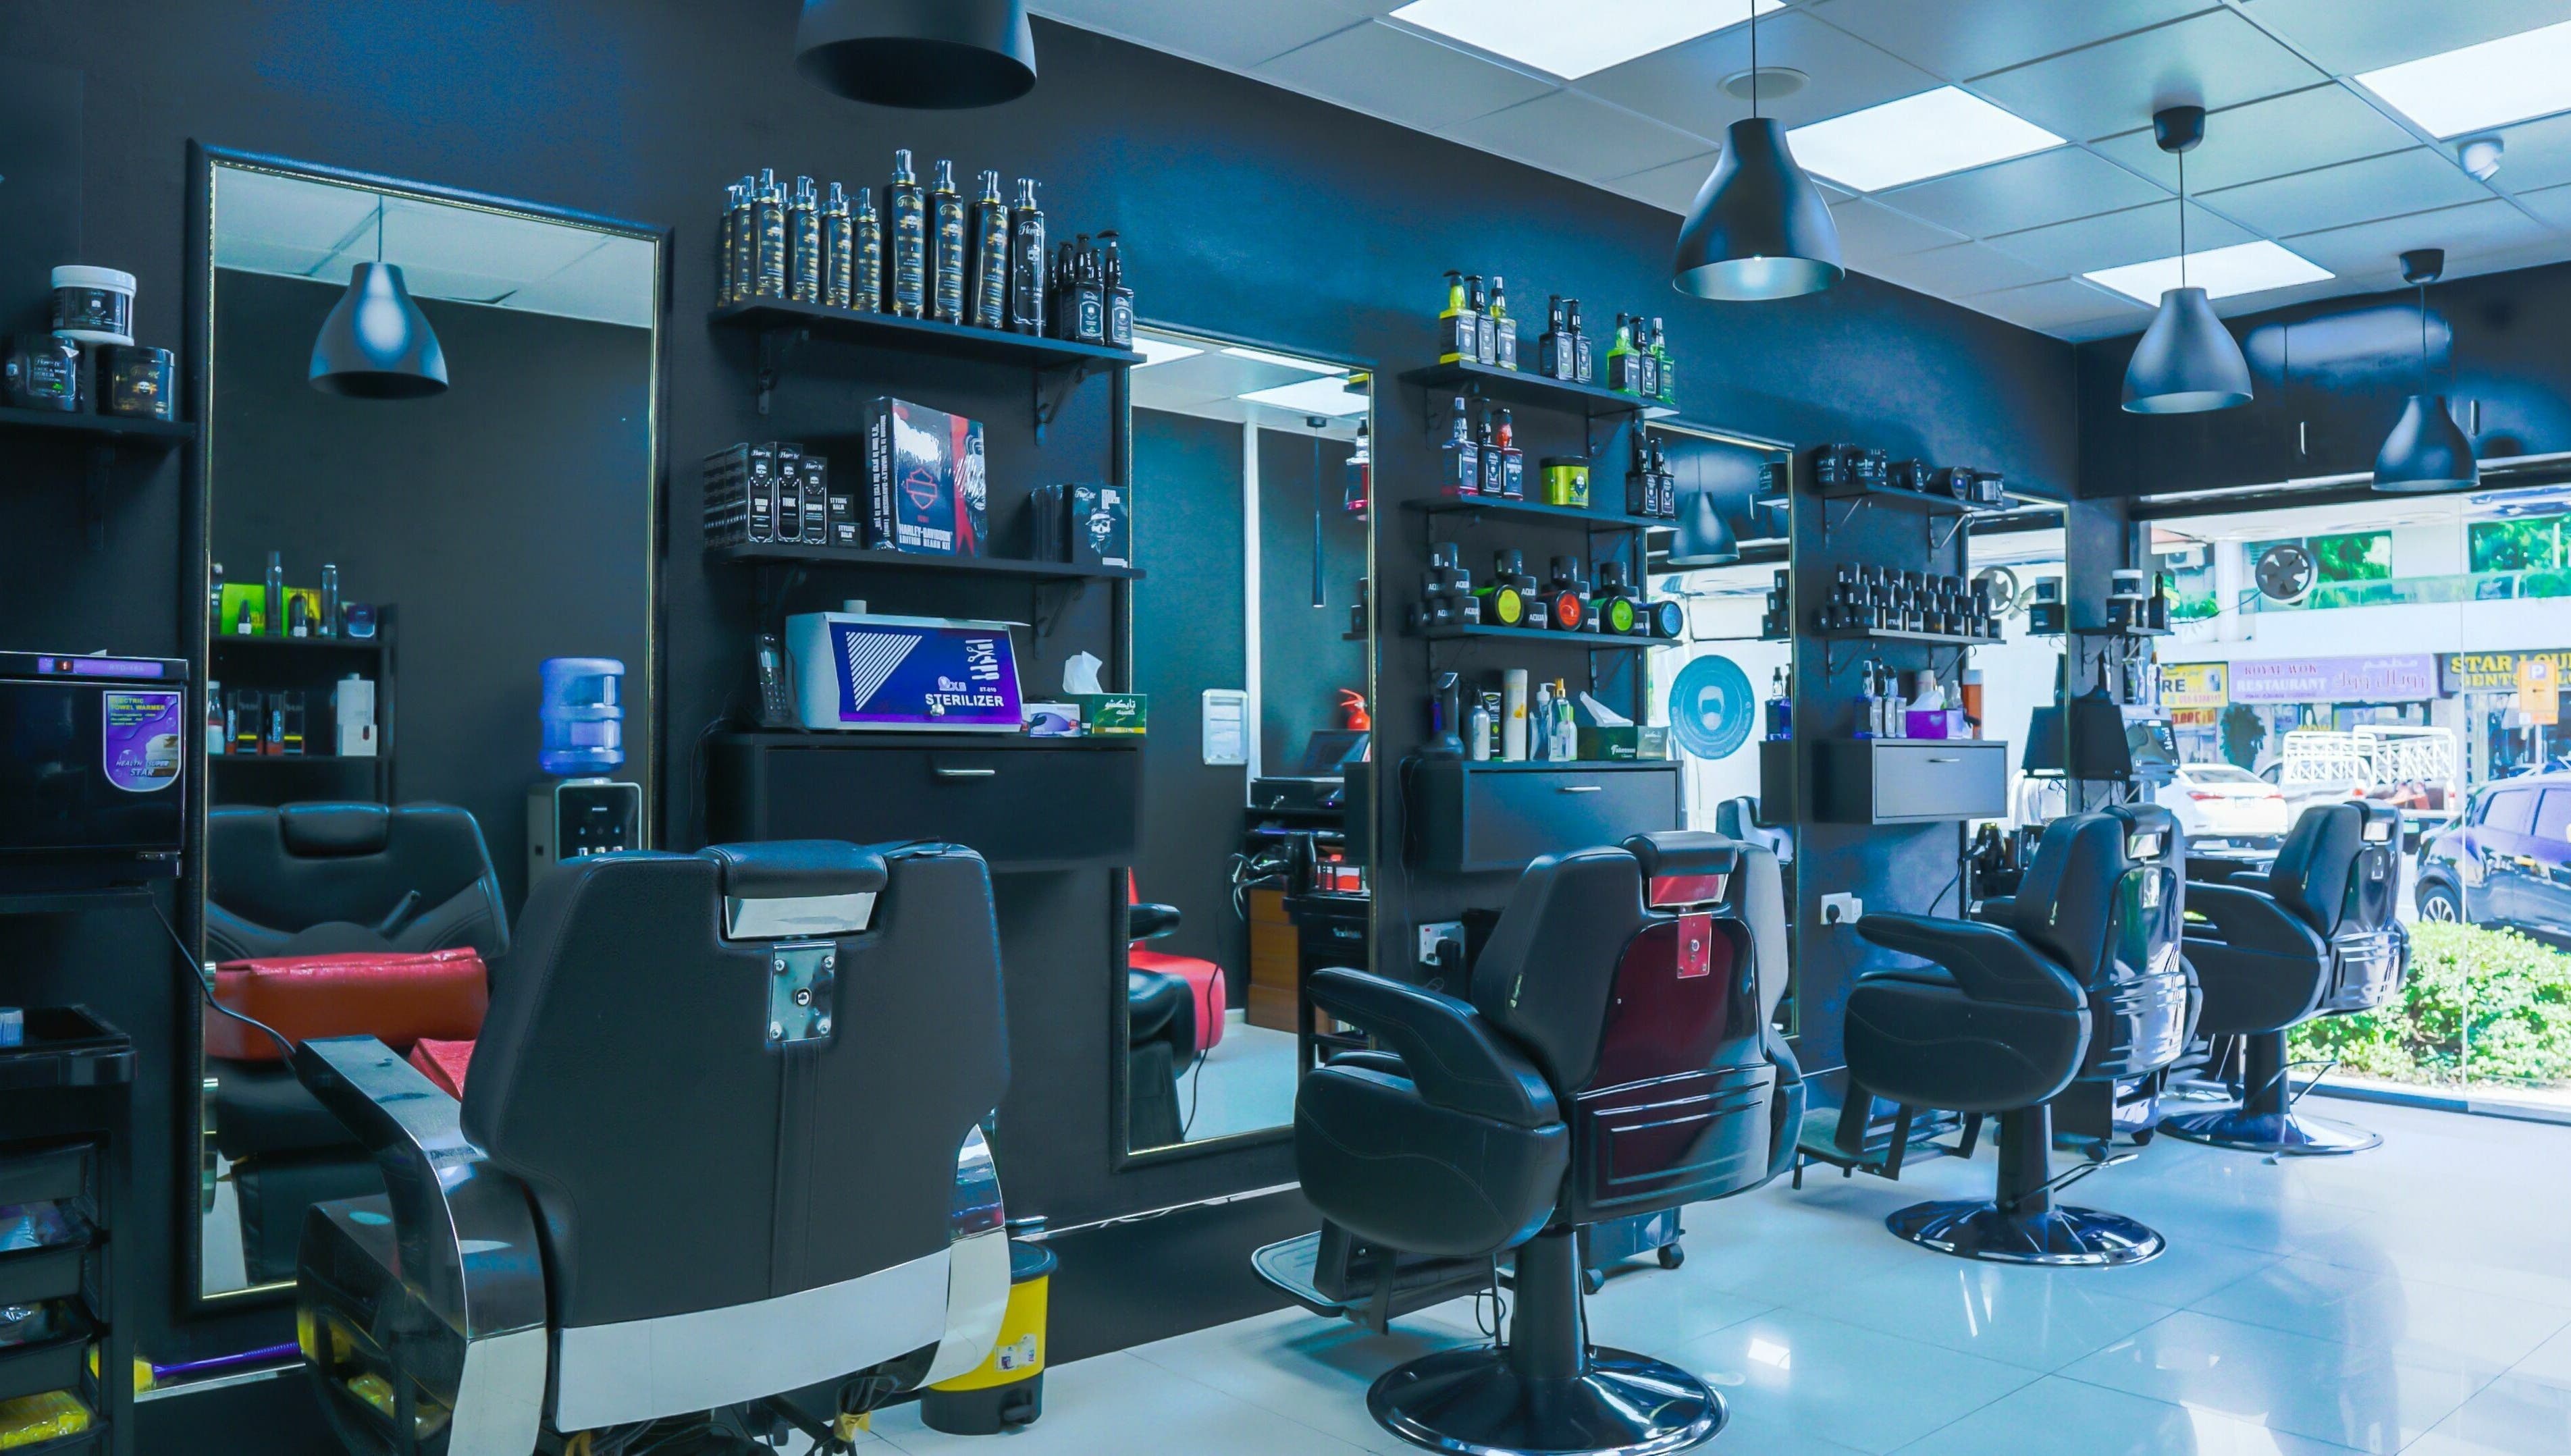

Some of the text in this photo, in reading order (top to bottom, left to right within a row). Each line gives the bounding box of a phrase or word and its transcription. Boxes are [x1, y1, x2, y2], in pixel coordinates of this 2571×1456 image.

[2451, 655, 2512, 674] STAR
[2236, 678, 2327, 692] RESTAURANT
[925, 693, 1005, 707] STERILIZER
